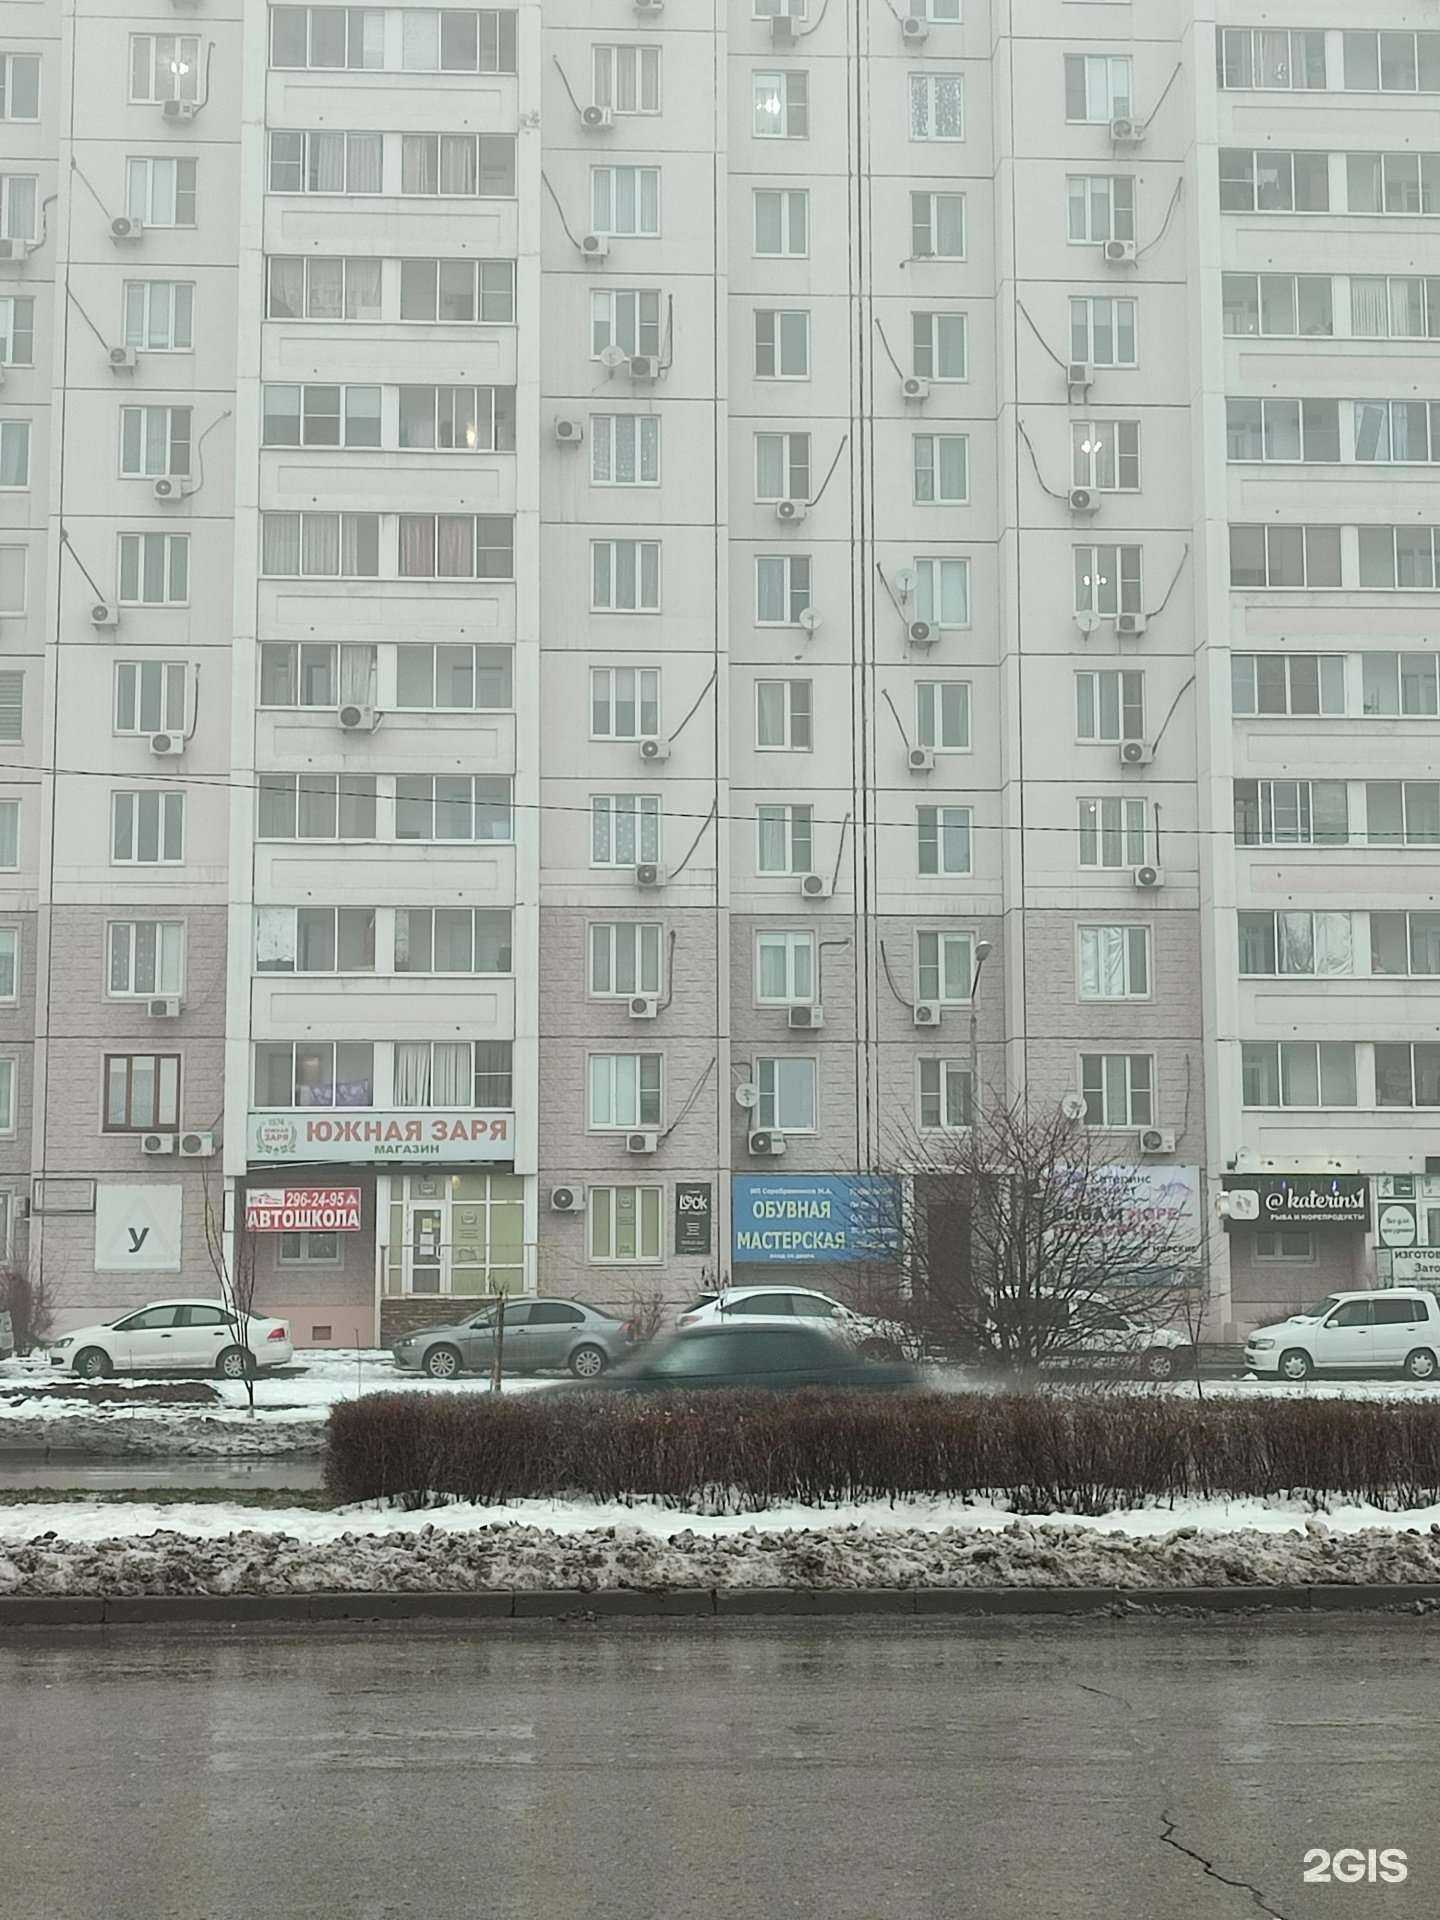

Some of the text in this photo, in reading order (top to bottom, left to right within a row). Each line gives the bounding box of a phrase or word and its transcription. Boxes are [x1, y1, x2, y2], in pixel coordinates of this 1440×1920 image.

[306, 1119, 508, 1142] ЮЖНАЯ ЗАРЯ
[374, 1144, 440, 1155] МАГАЗИН
[286, 1191, 345, 1207] 296-24-95
[247, 1208, 360, 1229] АВТОШКОЛА
[752, 1199, 831, 1219] ОБУВНАЯ
[1270, 1213, 1366, 1221] РЫБА И МОРЕПРОДУКТЫ
[737, 1231, 846, 1250] МАСТЕРСКАЯ
